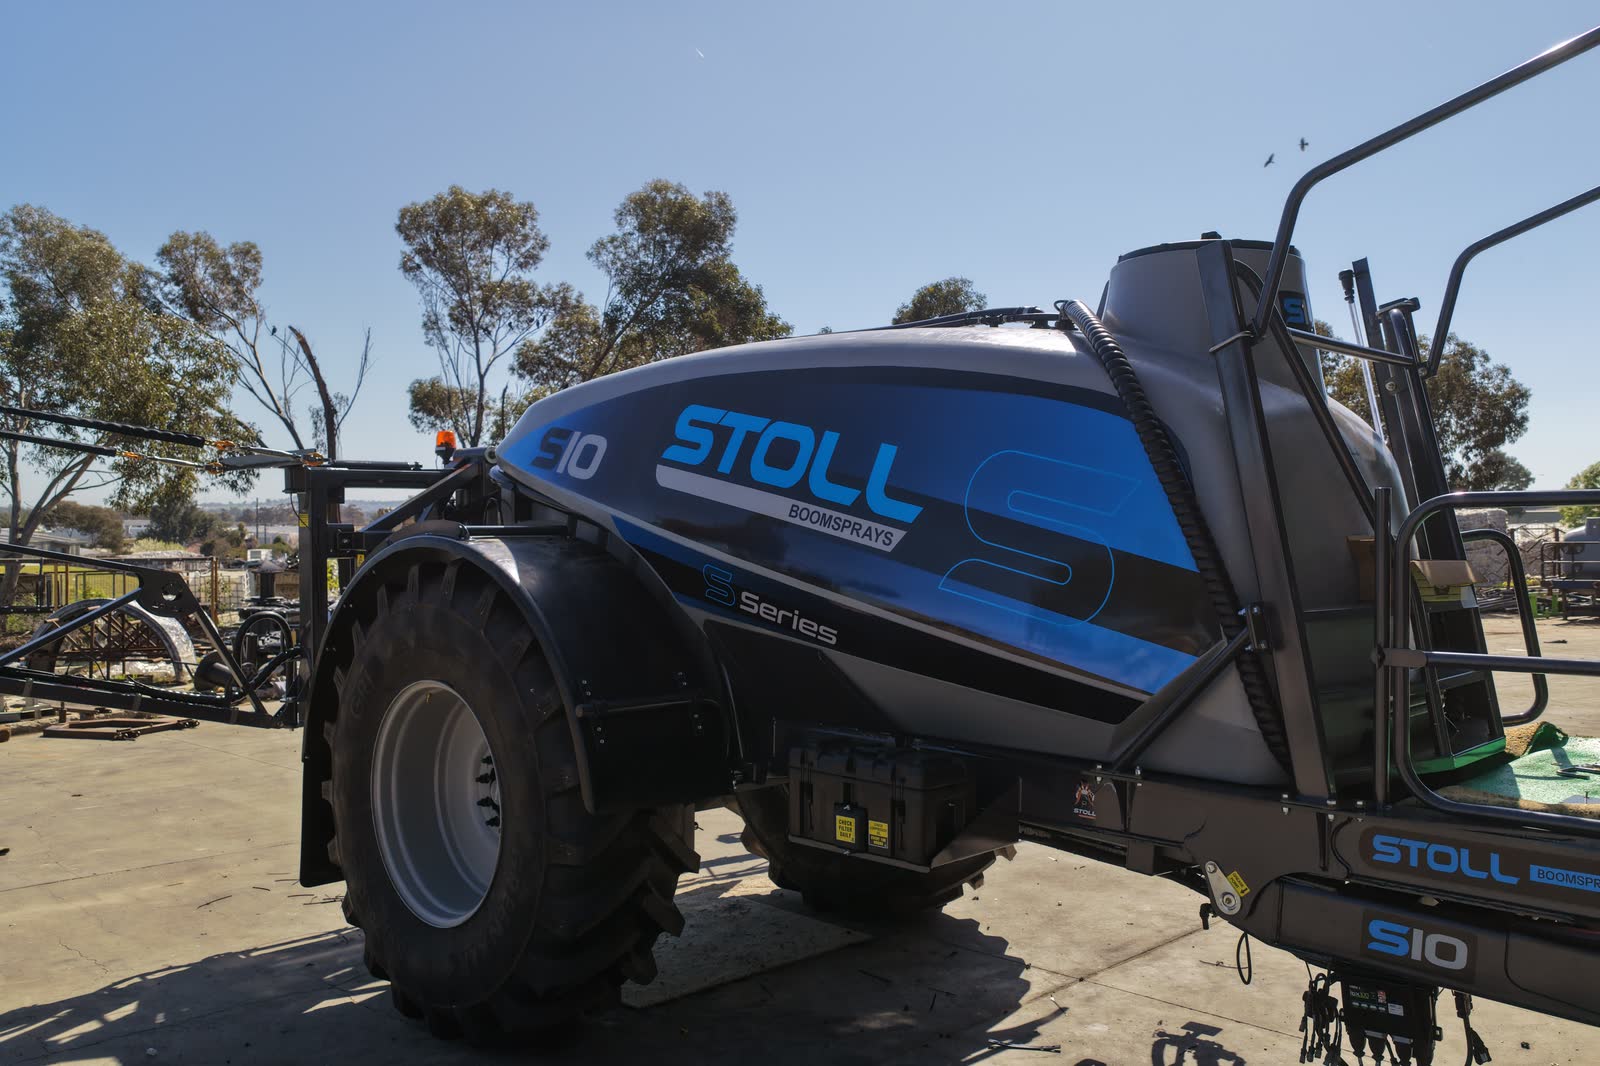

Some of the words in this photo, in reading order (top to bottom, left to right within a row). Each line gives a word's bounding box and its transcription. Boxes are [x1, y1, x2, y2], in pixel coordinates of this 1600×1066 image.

[531, 427, 608, 481] S10
[661, 404, 924, 524] STOLL
[788, 503, 895, 547] BOOMSPRAYS
[739, 591, 838, 645] Series
[1073, 807, 1096, 817] STOLL
[1372, 834, 1521, 886] STOLL
[1367, 919, 1468, 970] S10
